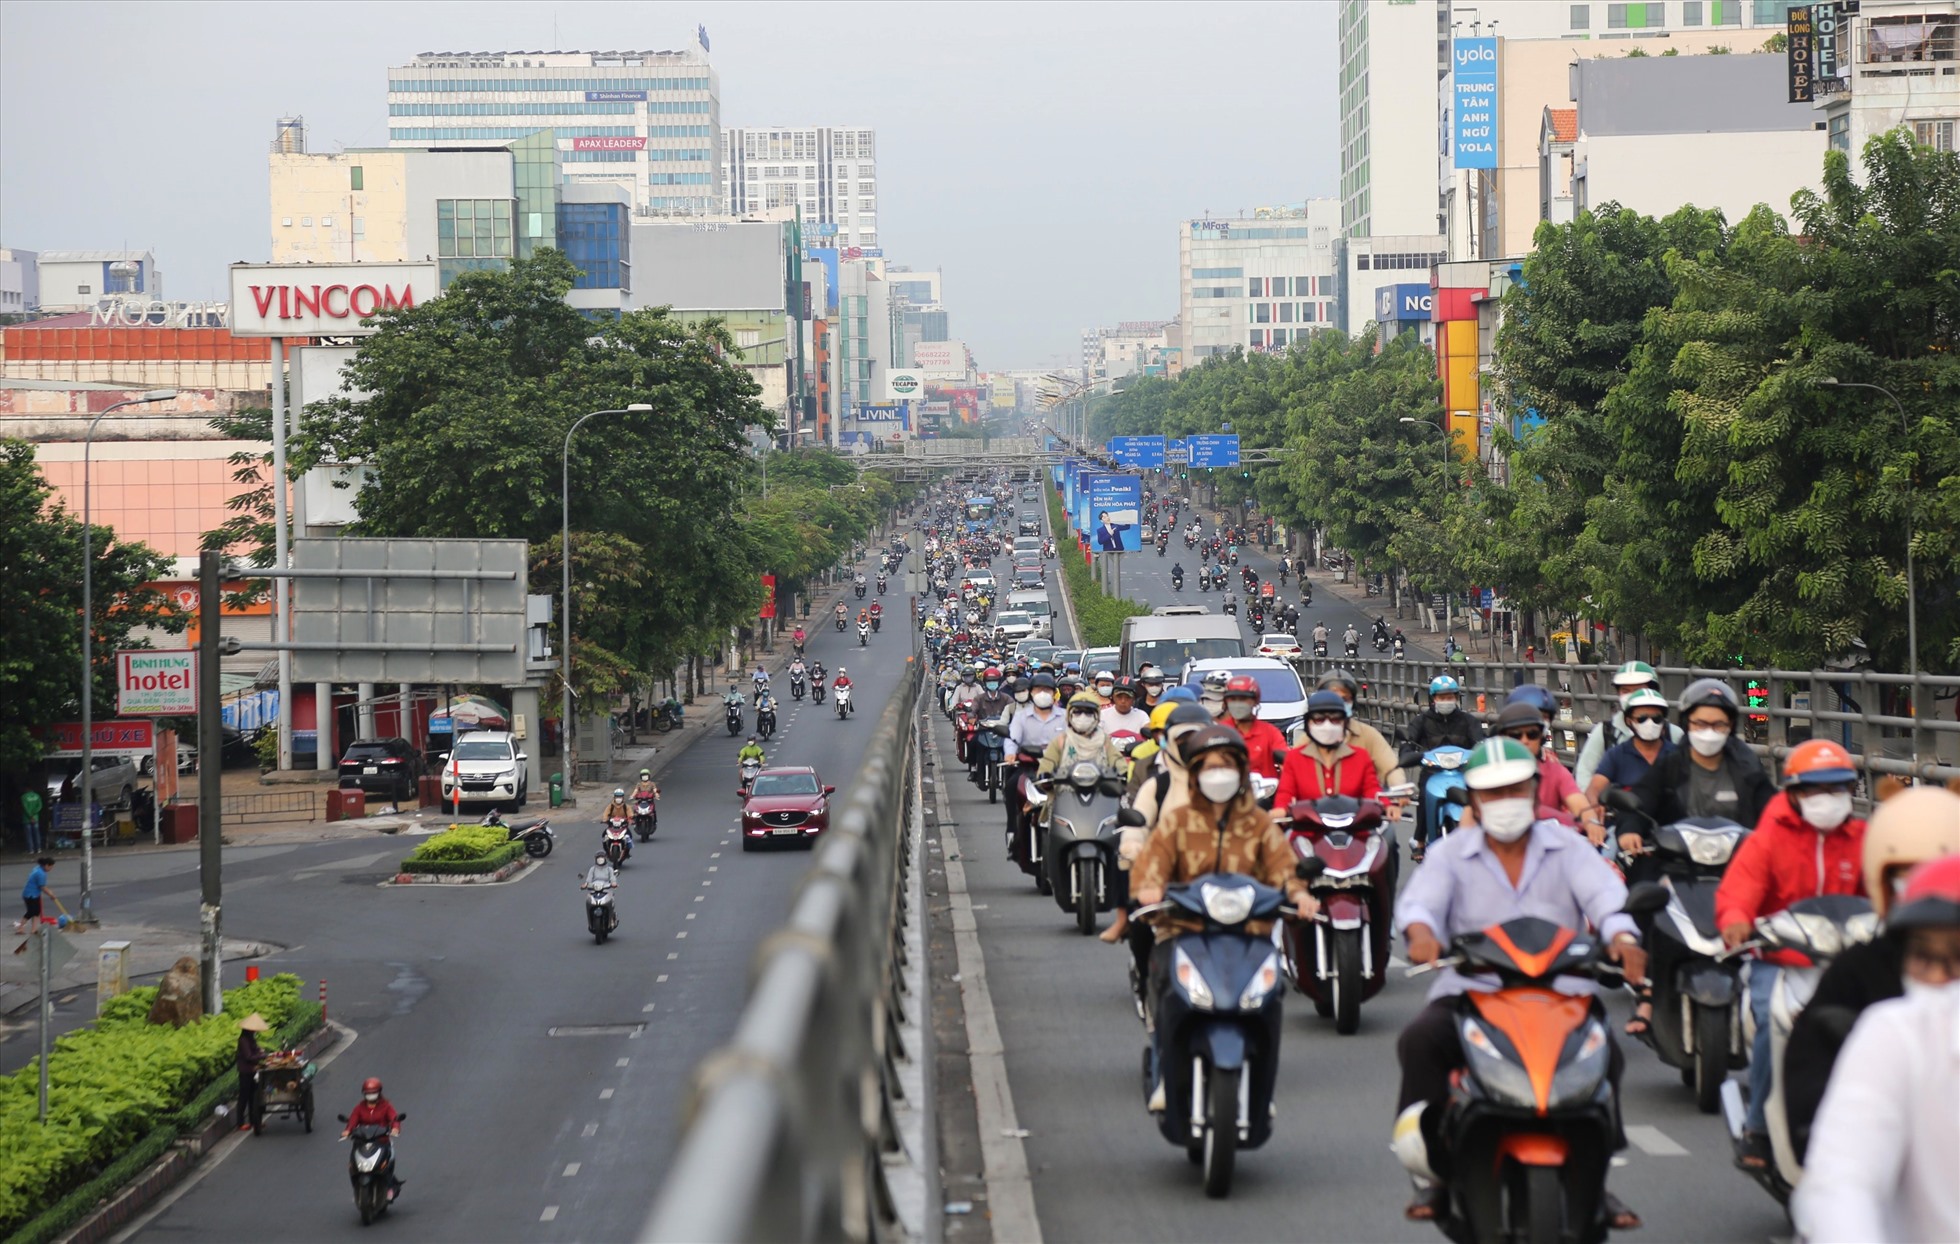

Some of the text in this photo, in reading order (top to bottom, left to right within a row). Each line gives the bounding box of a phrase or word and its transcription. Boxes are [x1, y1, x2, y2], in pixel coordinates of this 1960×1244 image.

[1791, 9, 1808, 21] ĐỨC
[1789, 23, 1810, 34] LONG
[1818, 5, 1835, 77] HOTEL
[1456, 45, 1495, 65] yola
[1793, 36, 1809, 100] HOTEL
[1456, 83, 1495, 93] TRUNG
[1462, 96, 1489, 107] TÂM
[1462, 113, 1489, 122] ANH
[1462, 126, 1490, 137] NGỮ
[579, 139, 643, 148] APAX LEADERS
[1459, 143, 1492, 152] YOLA
[1202, 221, 1230, 230] MFast
[248, 283, 414, 319] VINCOM
[132, 658, 157, 668] BÌNH
[125, 656, 190, 690] hotel
[119, 729, 145, 743] XE
